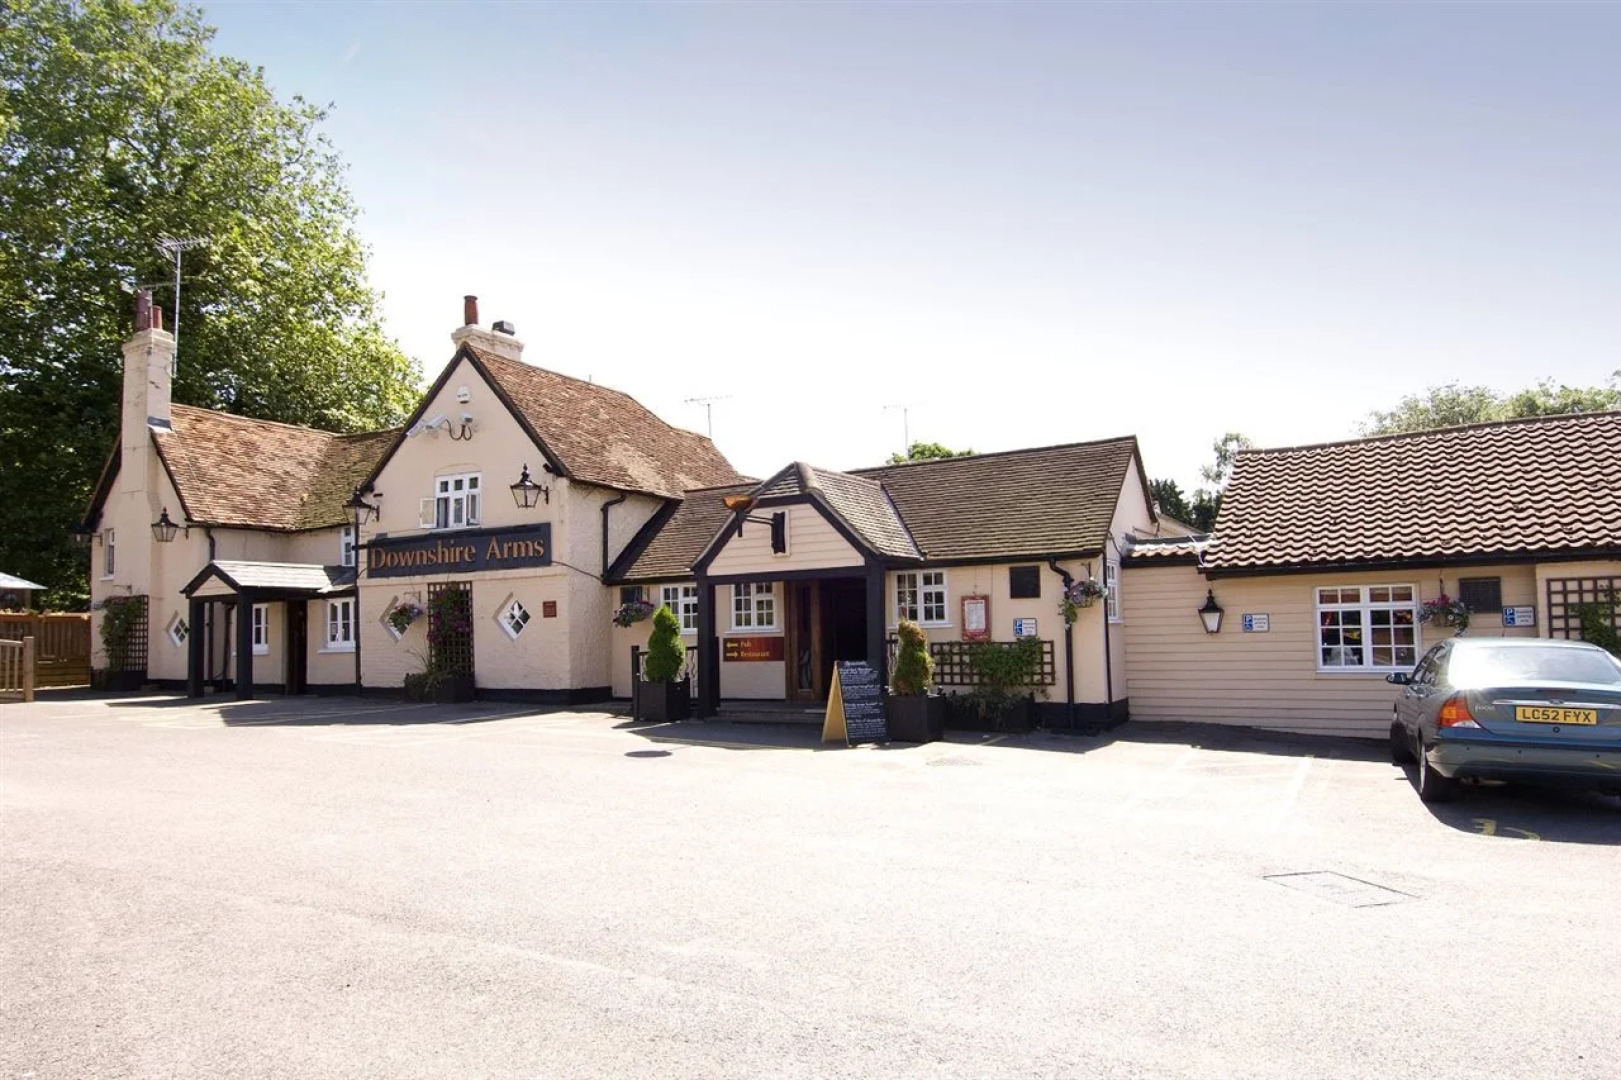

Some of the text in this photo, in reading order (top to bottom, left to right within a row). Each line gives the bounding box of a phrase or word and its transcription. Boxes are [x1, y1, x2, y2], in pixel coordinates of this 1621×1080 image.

[370, 536, 545, 569] Downshire Arms
[1522, 708, 1592, 723] LC52 FYX
